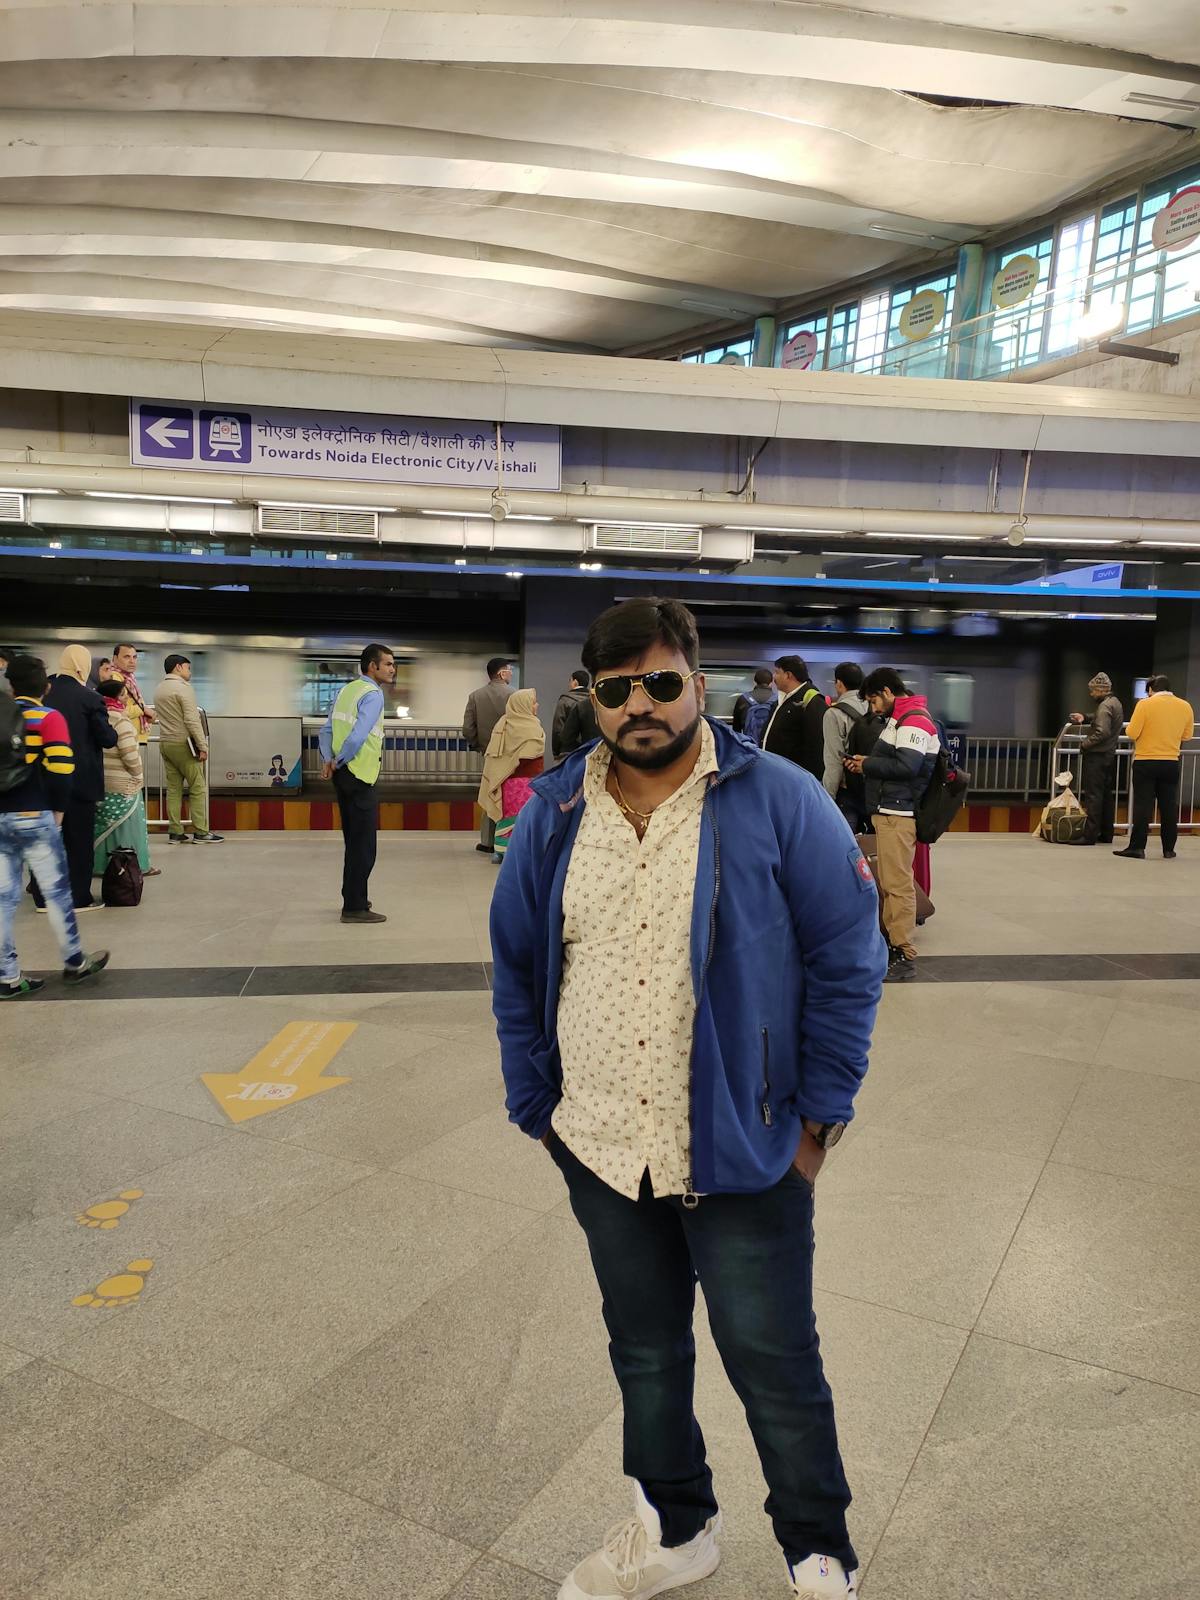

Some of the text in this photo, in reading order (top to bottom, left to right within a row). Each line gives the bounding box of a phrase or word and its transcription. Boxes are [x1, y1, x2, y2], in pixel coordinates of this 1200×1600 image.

[257, 419, 296, 440] नोएडा
[468, 434, 487, 451] की
[258, 445, 322, 461] Towards
[326, 449, 367, 464] Noida
[372, 452, 442, 468] Electronic
